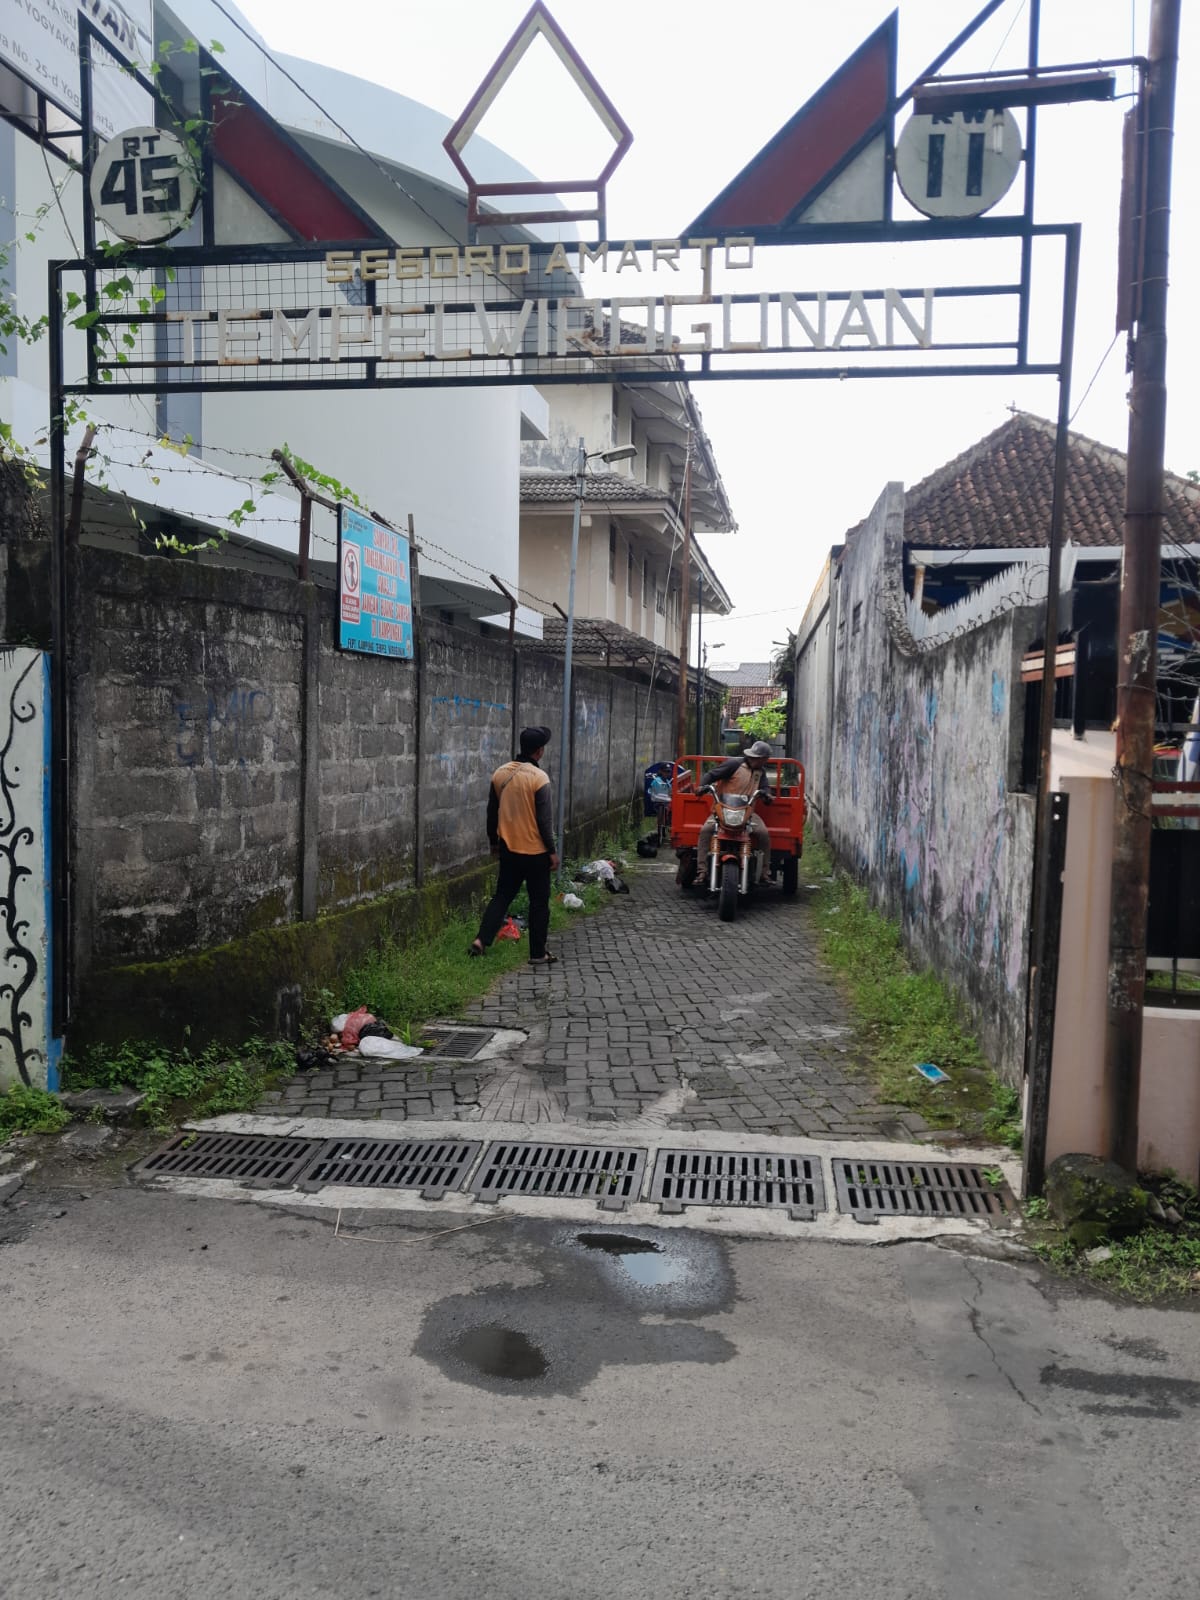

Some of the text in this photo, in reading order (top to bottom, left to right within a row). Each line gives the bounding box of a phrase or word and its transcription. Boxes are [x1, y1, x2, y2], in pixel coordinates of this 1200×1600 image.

[122, 135, 161, 158] RT
[926, 133, 985, 198] 11
[101, 155, 181, 215] 45
[325, 236, 756, 283] SEGORO AMARTO
